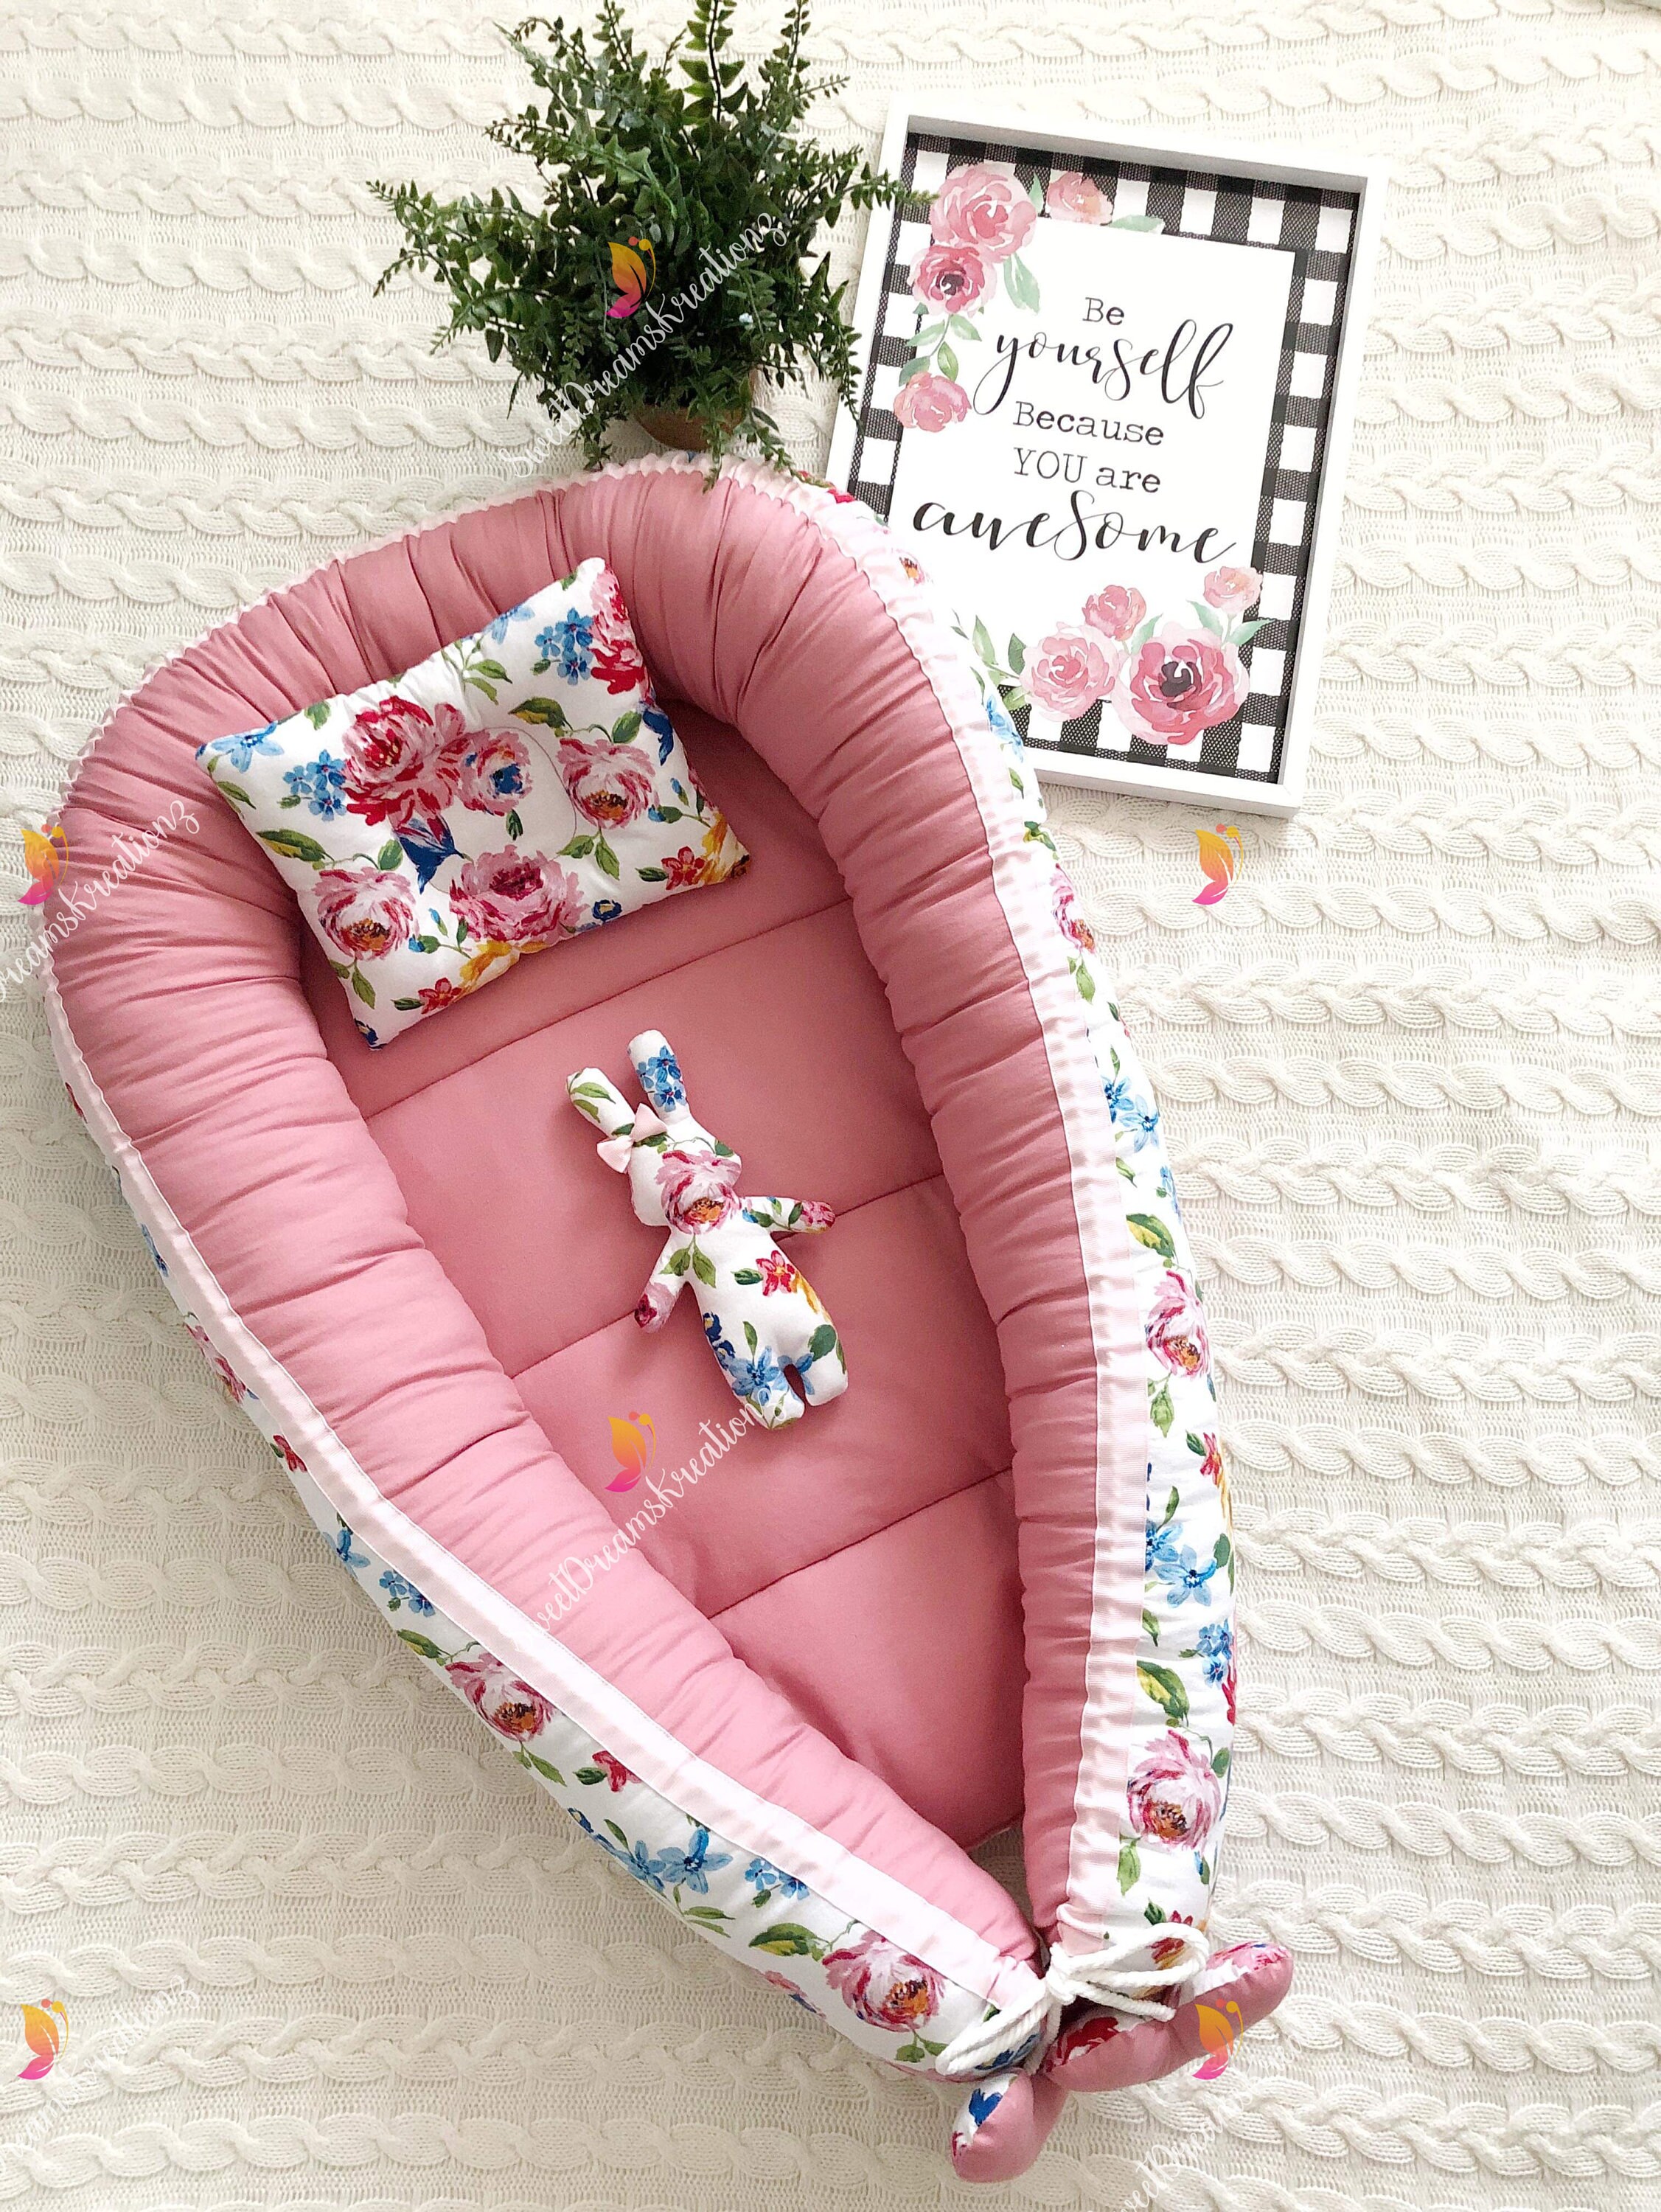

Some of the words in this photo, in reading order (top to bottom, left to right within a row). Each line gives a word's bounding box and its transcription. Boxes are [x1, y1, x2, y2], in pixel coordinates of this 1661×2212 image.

[1082, 297, 1125, 326] Be
[1012, 400, 1164, 446] Because
[1014, 447, 1087, 483] YOU
[1096, 467, 1161, 493] are
